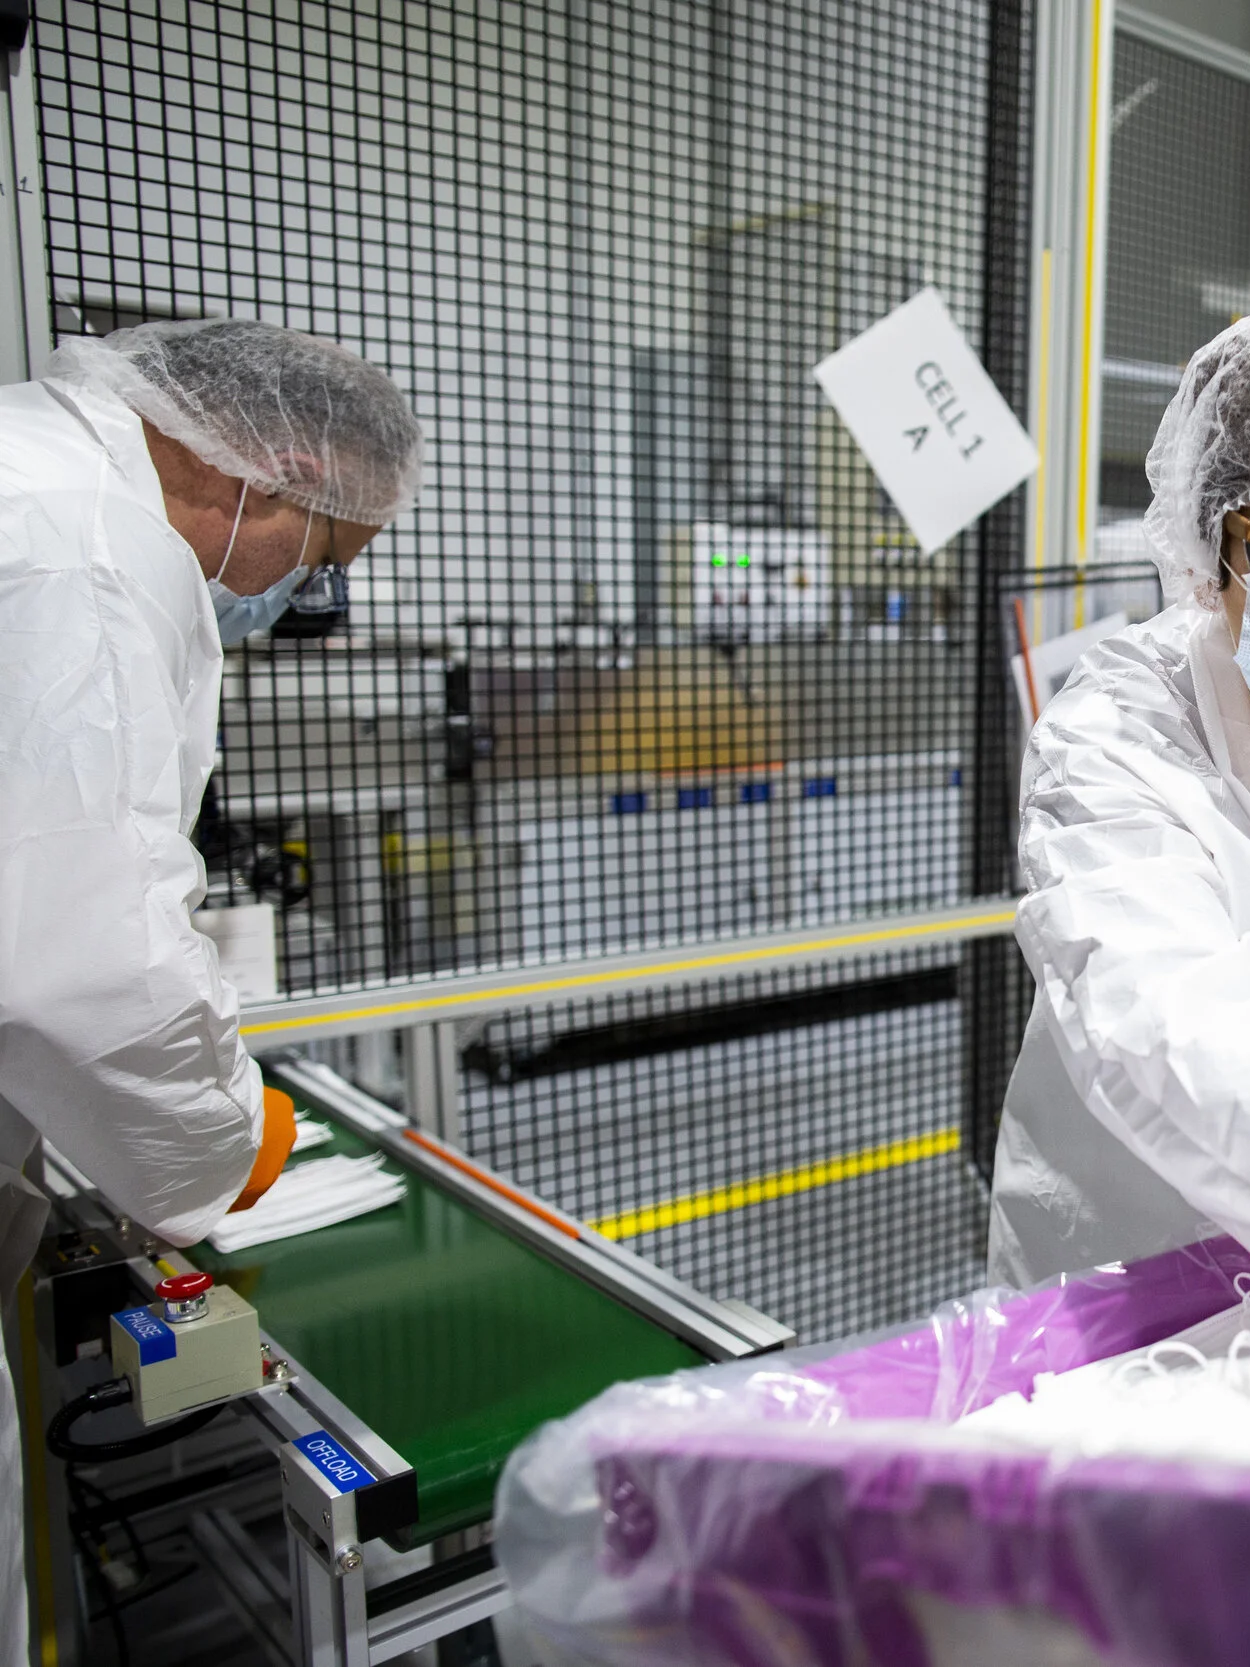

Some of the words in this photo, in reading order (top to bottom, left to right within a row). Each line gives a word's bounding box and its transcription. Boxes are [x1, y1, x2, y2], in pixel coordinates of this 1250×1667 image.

[915, 361, 967, 437] CELL
[960, 435, 985, 461] 1
[902, 425, 930, 453] A
[124, 1311, 162, 1338] PAUSE
[307, 1440, 357, 1482] OFFLOAD
